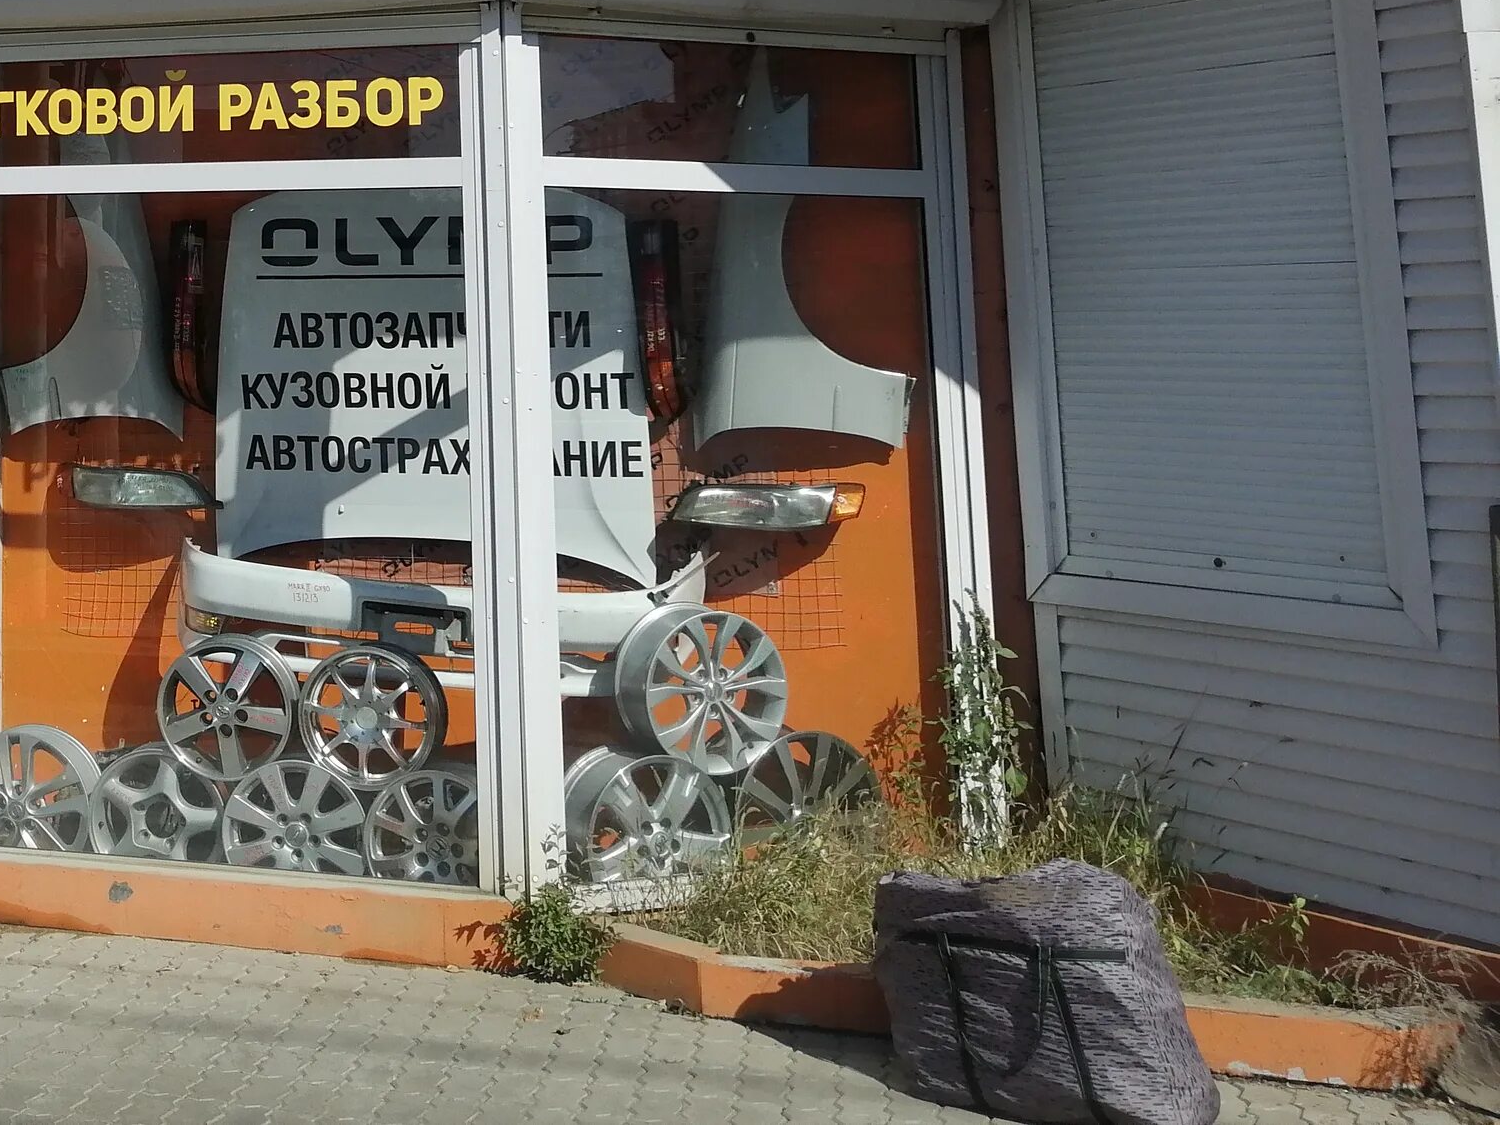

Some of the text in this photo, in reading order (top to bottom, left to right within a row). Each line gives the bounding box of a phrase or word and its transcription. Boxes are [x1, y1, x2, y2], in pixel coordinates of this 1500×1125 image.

[217, 76, 445, 131] РАЗБОР
[260, 215, 594, 267] OLYP
[273, 311, 592, 349] АВТОЗАПТИ
[241, 363, 635, 411] КУЗОВНОЙ ОНТ
[246, 434, 645, 478] АВТОСТРАХНИЕ
